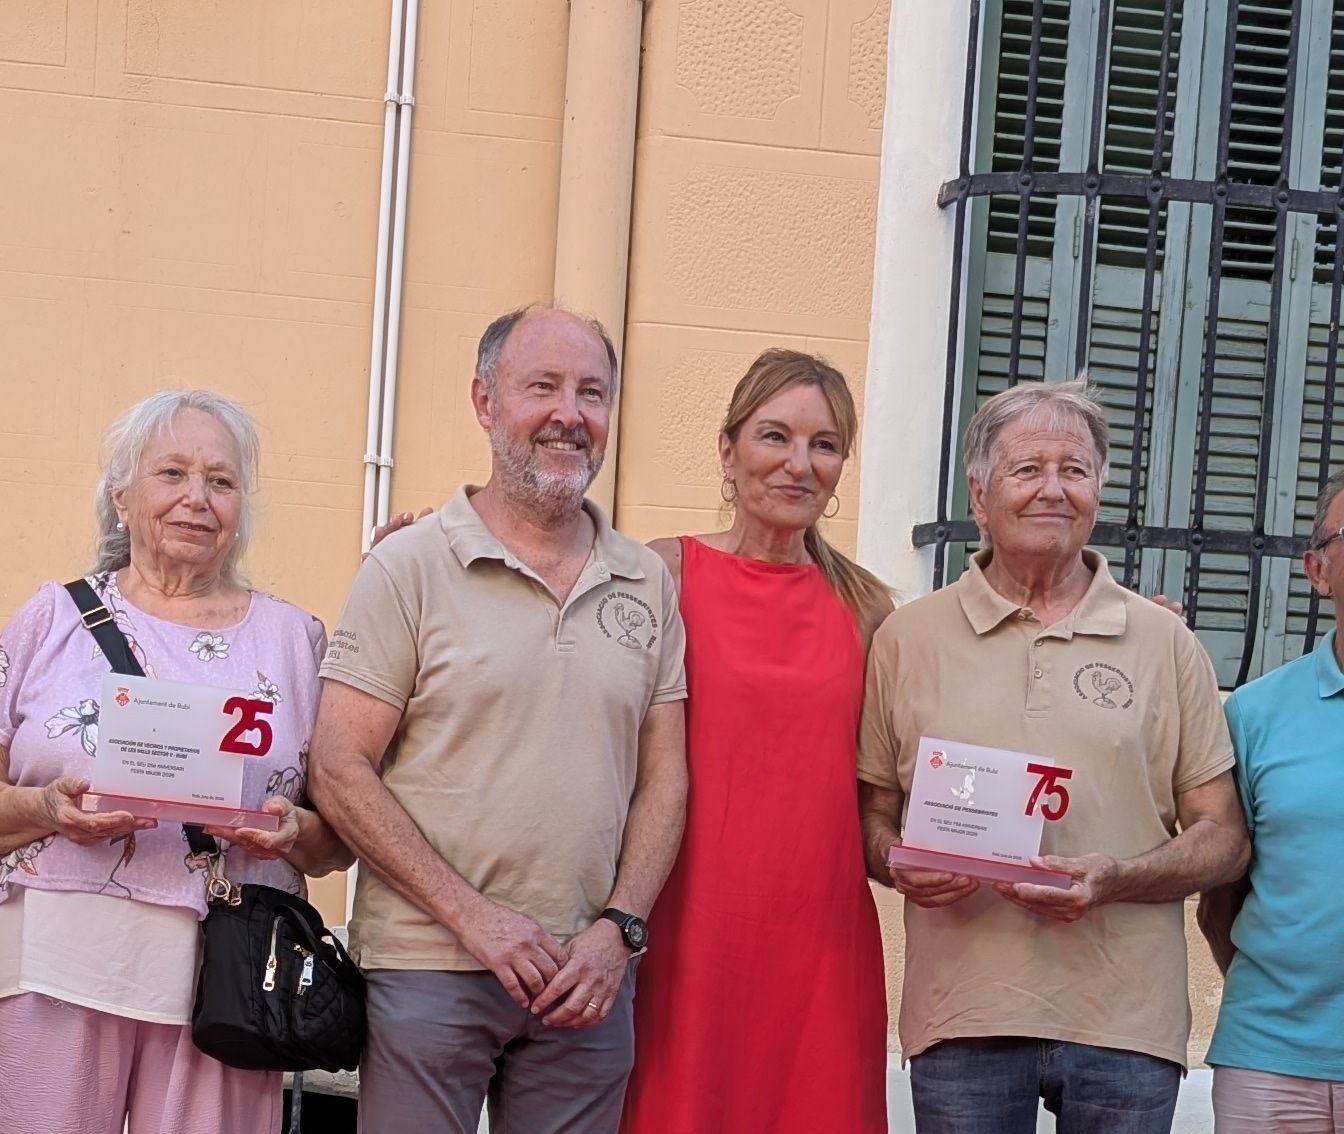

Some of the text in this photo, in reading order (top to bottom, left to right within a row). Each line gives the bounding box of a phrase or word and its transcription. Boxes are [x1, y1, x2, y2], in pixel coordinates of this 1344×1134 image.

[134, 698, 167, 706] Ajuntament
[219, 697, 274, 757] 25
[1024, 762, 1073, 821] 75
